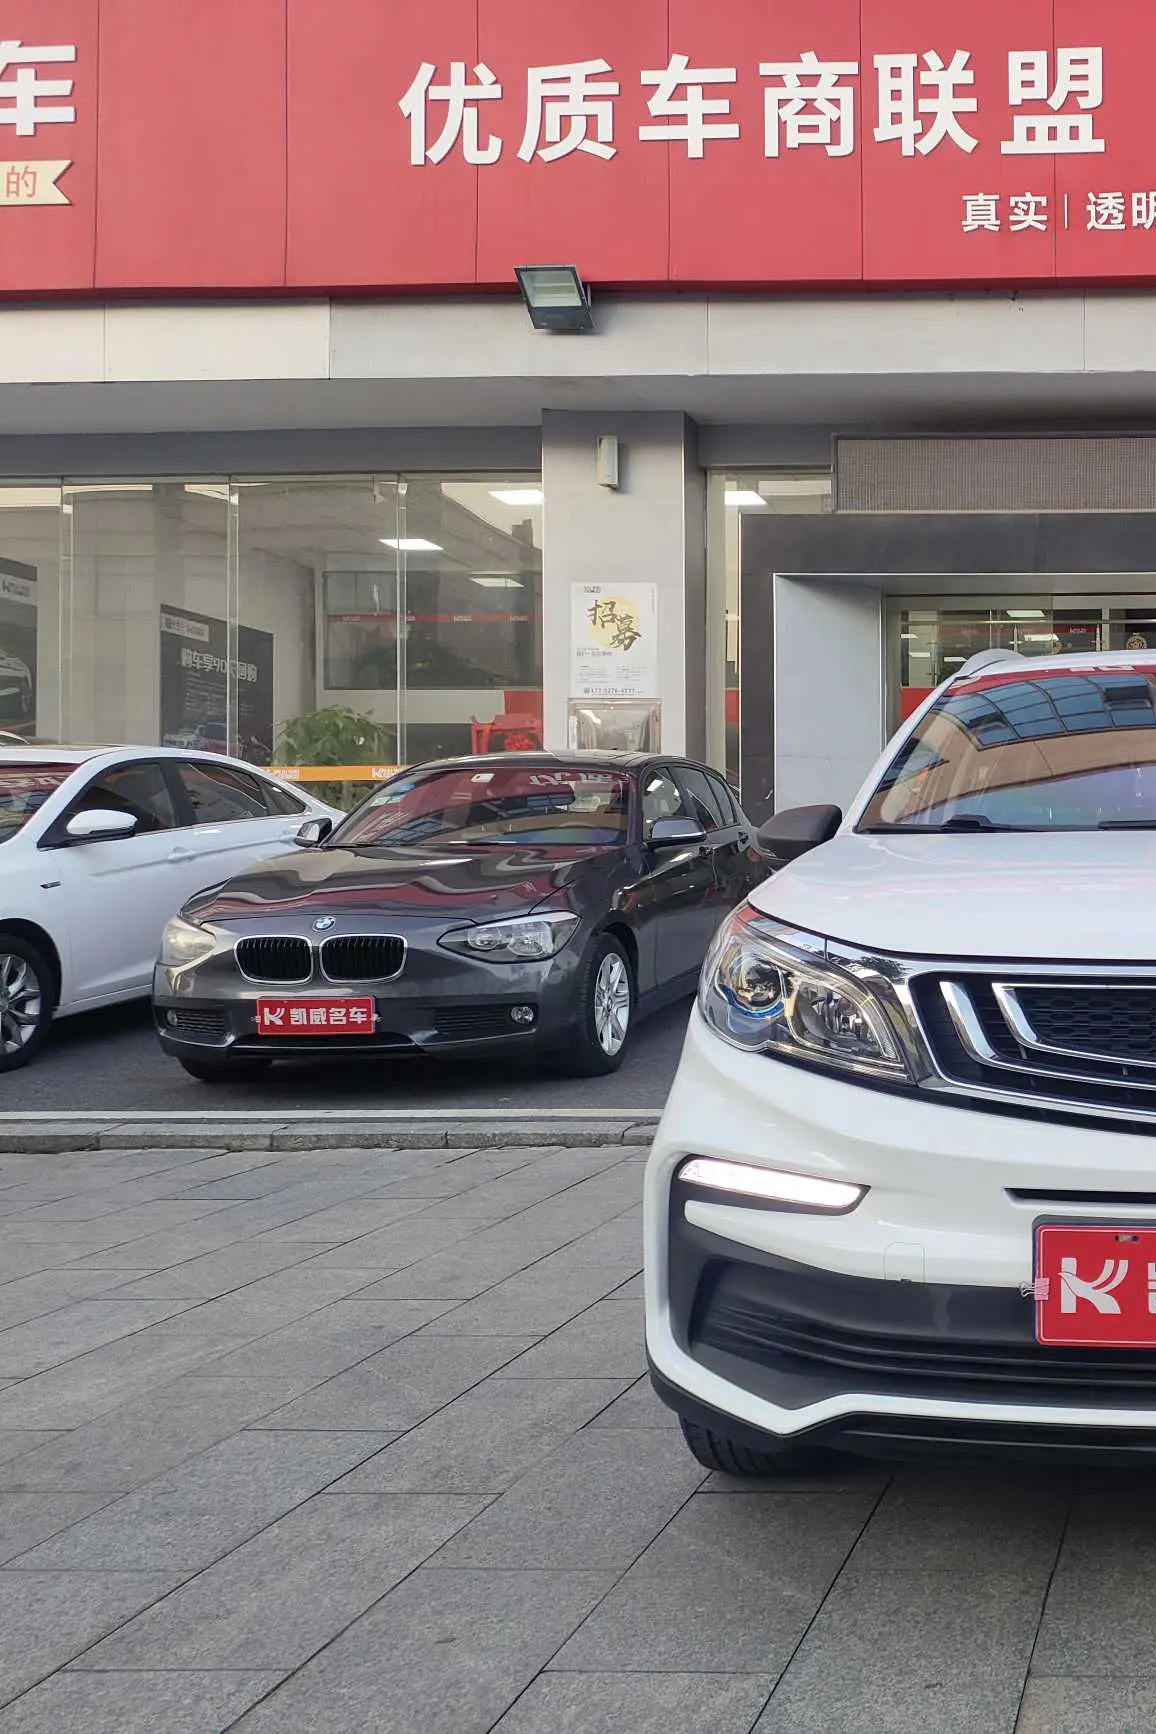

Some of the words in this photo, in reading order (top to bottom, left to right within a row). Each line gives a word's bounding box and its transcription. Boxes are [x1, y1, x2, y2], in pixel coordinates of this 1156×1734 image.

[398, 46, 1105, 165] 优质车商联盟
[6, 165, 38, 199] 的
[961, 191, 1048, 232] 真实
[290, 1007, 368, 1026] 凯威名车
